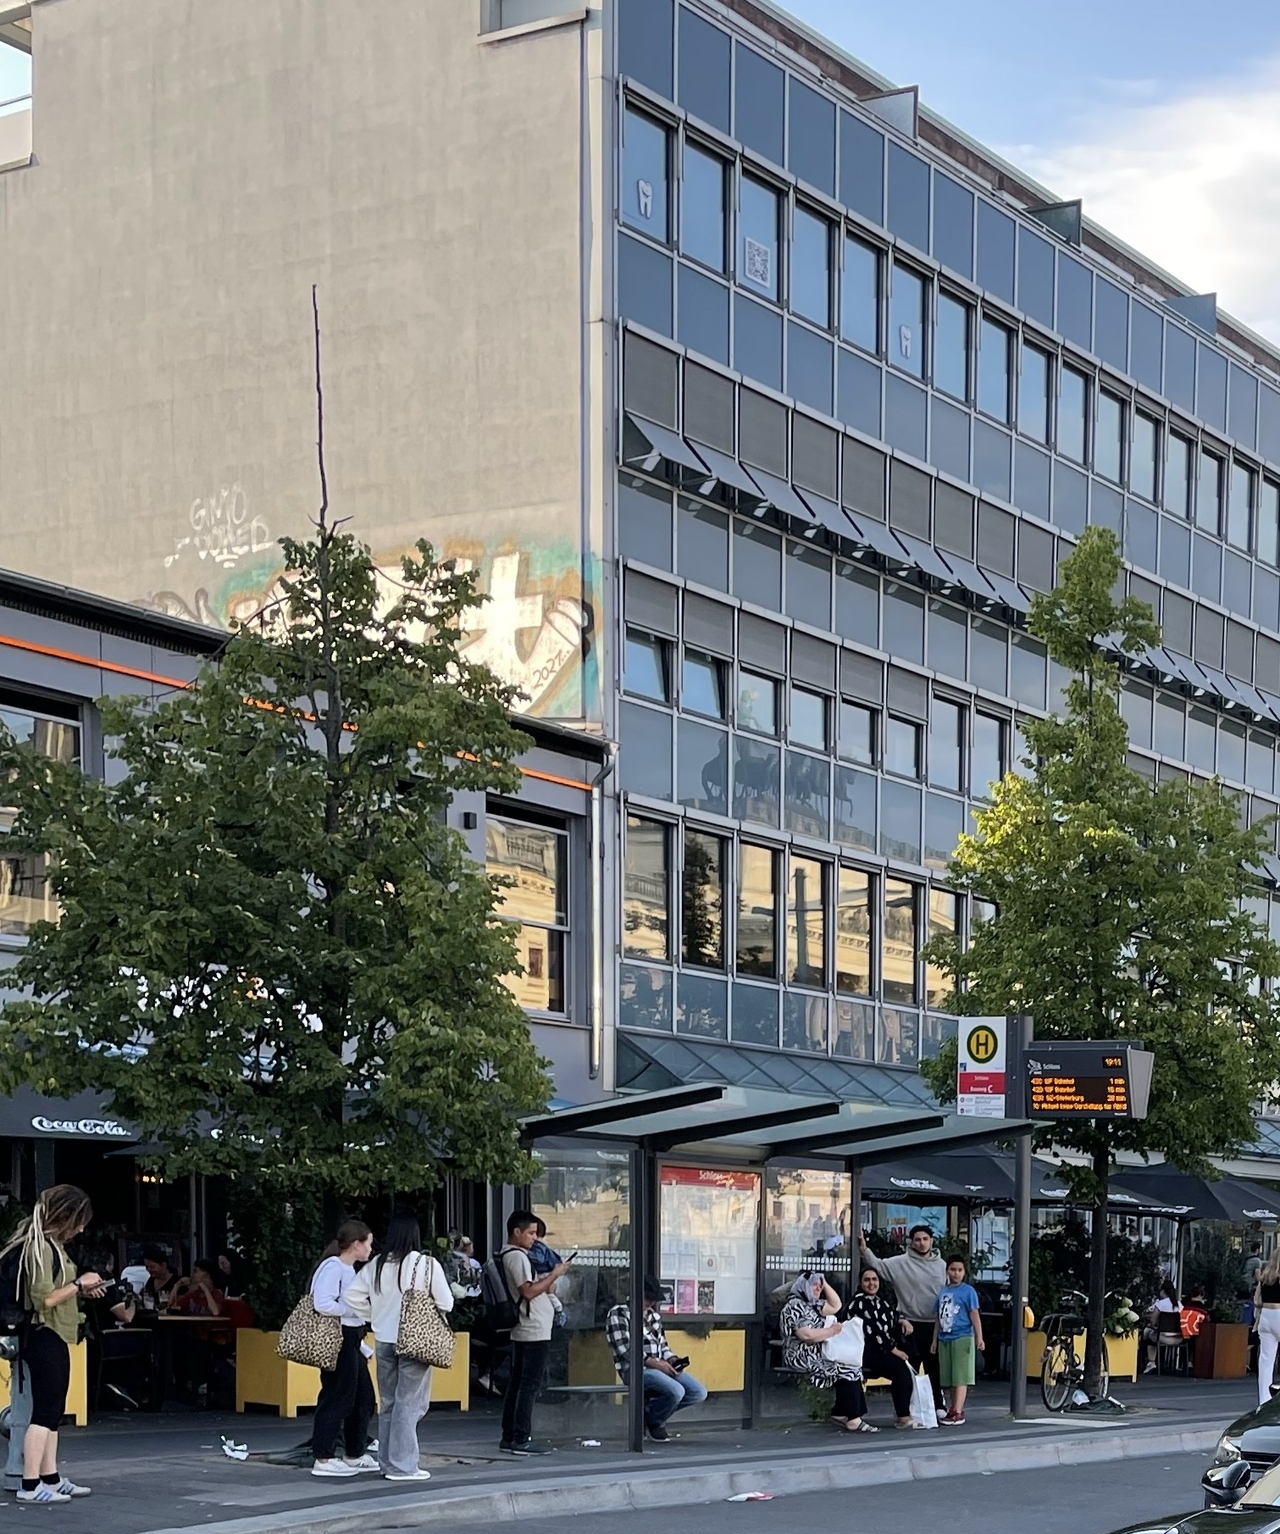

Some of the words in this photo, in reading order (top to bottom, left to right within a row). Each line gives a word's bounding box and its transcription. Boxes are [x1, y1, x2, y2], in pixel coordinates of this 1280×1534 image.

[976, 1034, 989, 1055] H
[1105, 1058, 1122, 1067] 19:11
[988, 1084, 994, 1094] C
